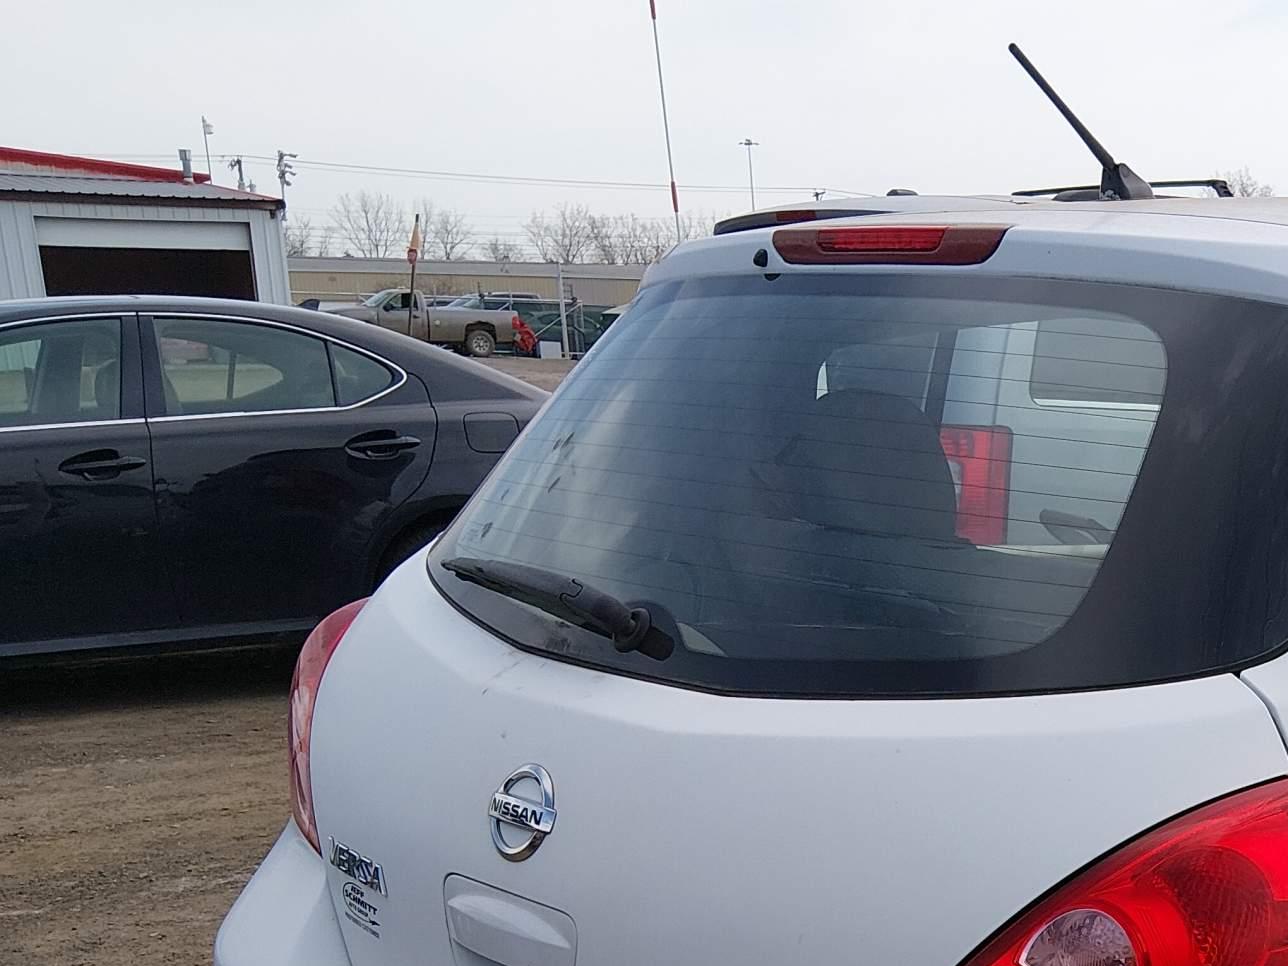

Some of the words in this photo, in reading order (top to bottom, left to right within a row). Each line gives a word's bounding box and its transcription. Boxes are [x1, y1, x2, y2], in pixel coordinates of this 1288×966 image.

[490, 797, 543, 826] NISSAN
[328, 835, 388, 898] VERSA
[344, 889, 378, 916] SCHMITT
